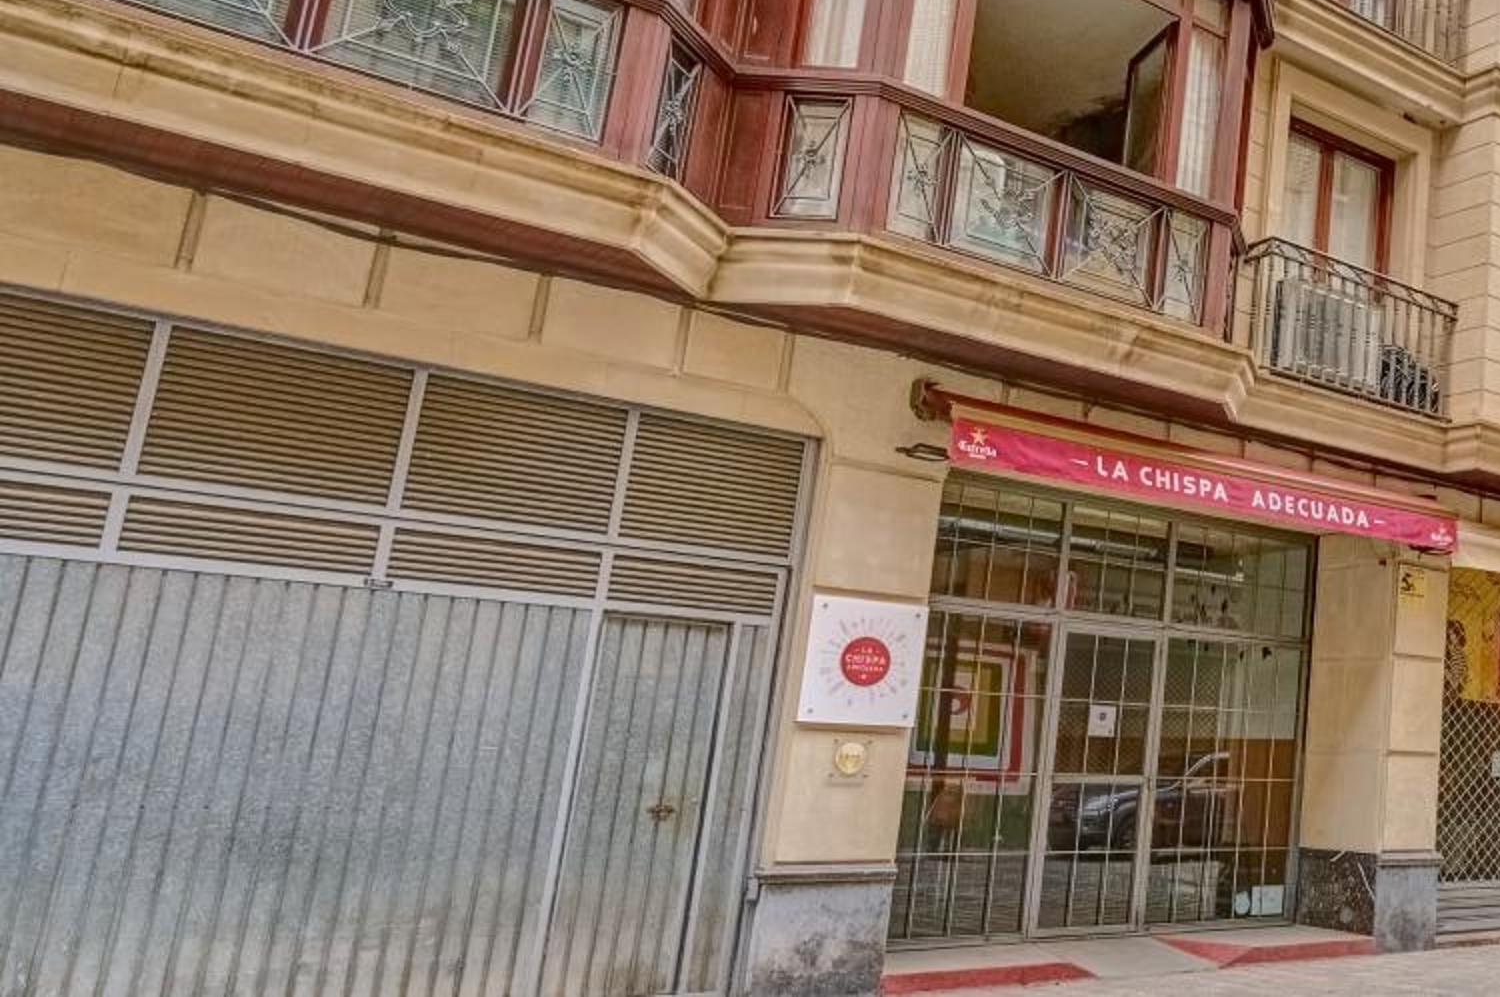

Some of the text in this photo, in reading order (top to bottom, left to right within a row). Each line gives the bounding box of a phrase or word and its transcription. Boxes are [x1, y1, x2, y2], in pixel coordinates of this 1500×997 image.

[1096, 455, 1370, 528] LA CHISPA ADECUADA
[845, 654, 886, 665] CHISPA
